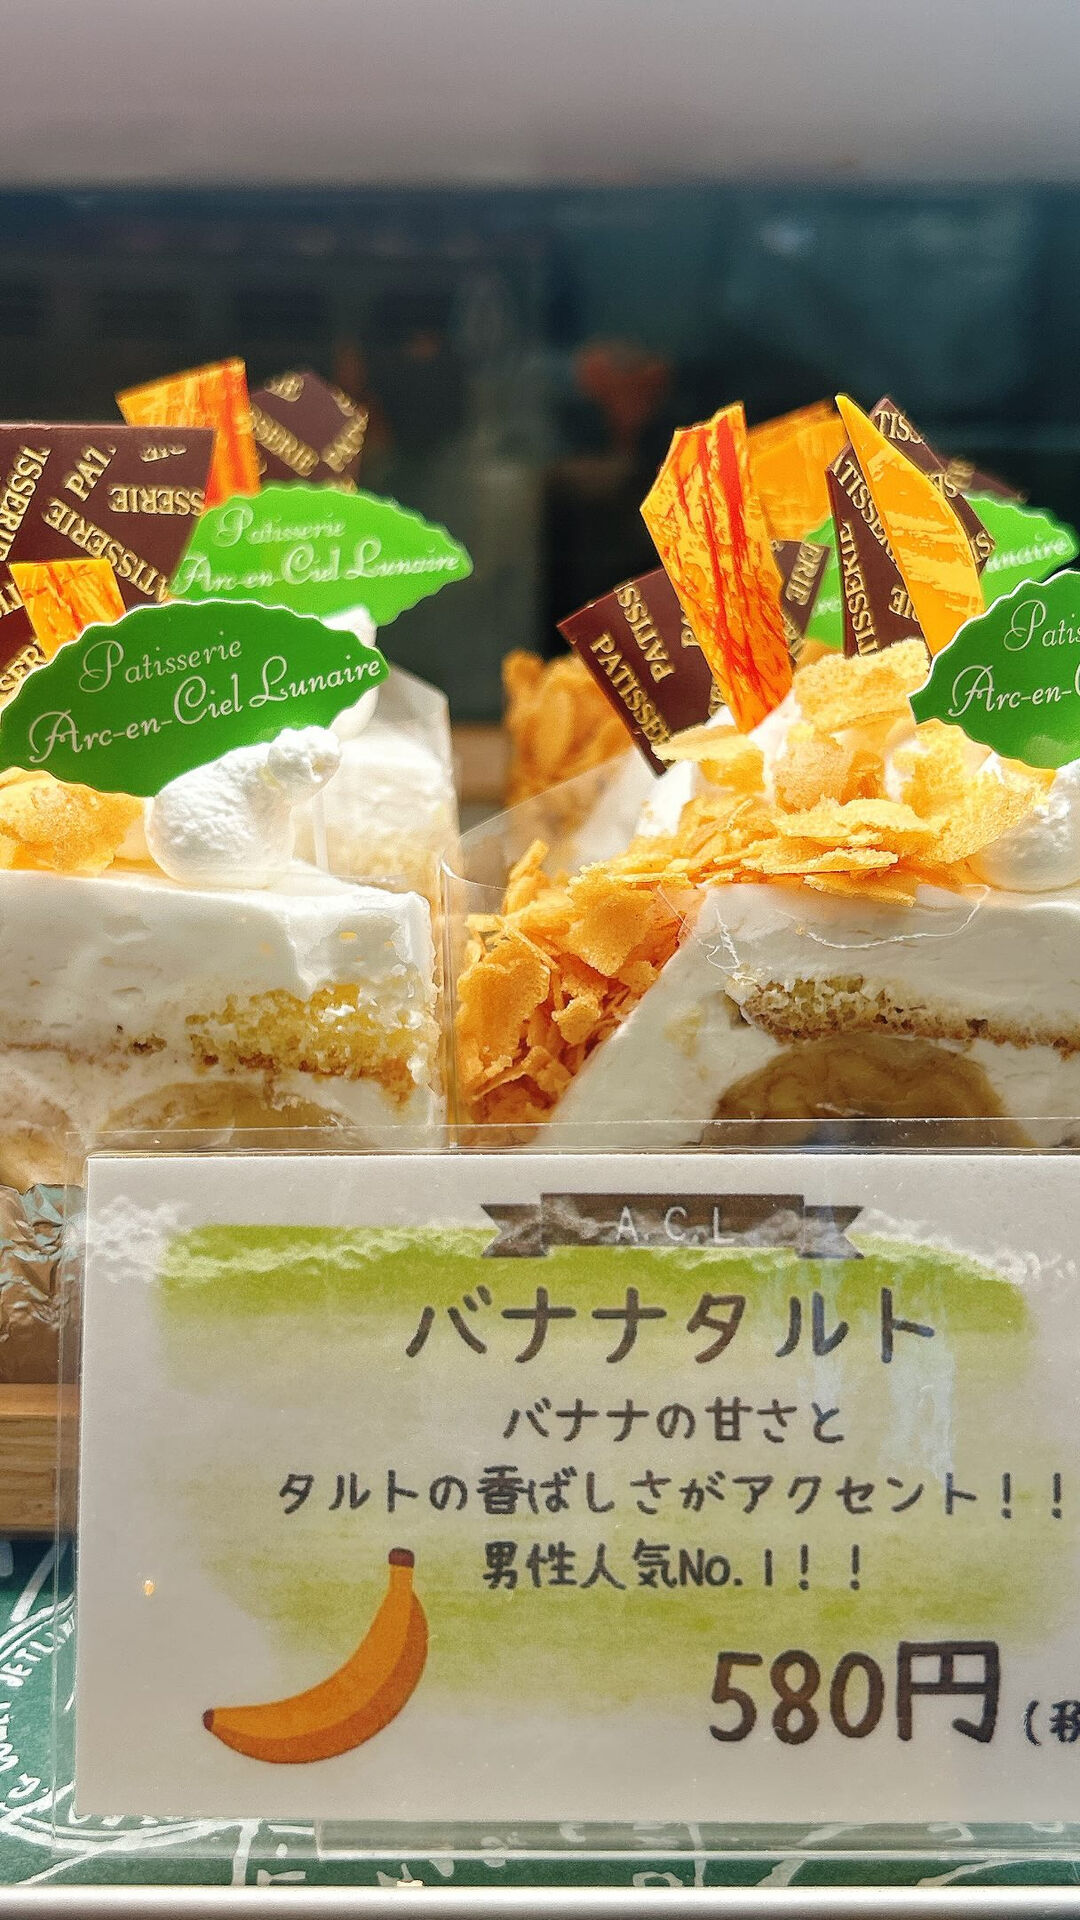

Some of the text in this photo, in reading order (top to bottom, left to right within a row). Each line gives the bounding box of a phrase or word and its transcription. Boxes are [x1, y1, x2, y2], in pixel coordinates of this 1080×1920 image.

[213, 503, 346, 548] Patisserie
[346, 534, 460, 580] Lunaire
[79, 630, 243, 694] Patisserie
[948, 664, 1080, 717] Arc-en-
[29, 655, 381, 763] Arc-en-Ciel Lunaire
[405, 1286, 935, 1364] バナナタルト
[503, 1396, 845, 1444] バナナの甘さと
[709, 1640, 1000, 1746] 580円
